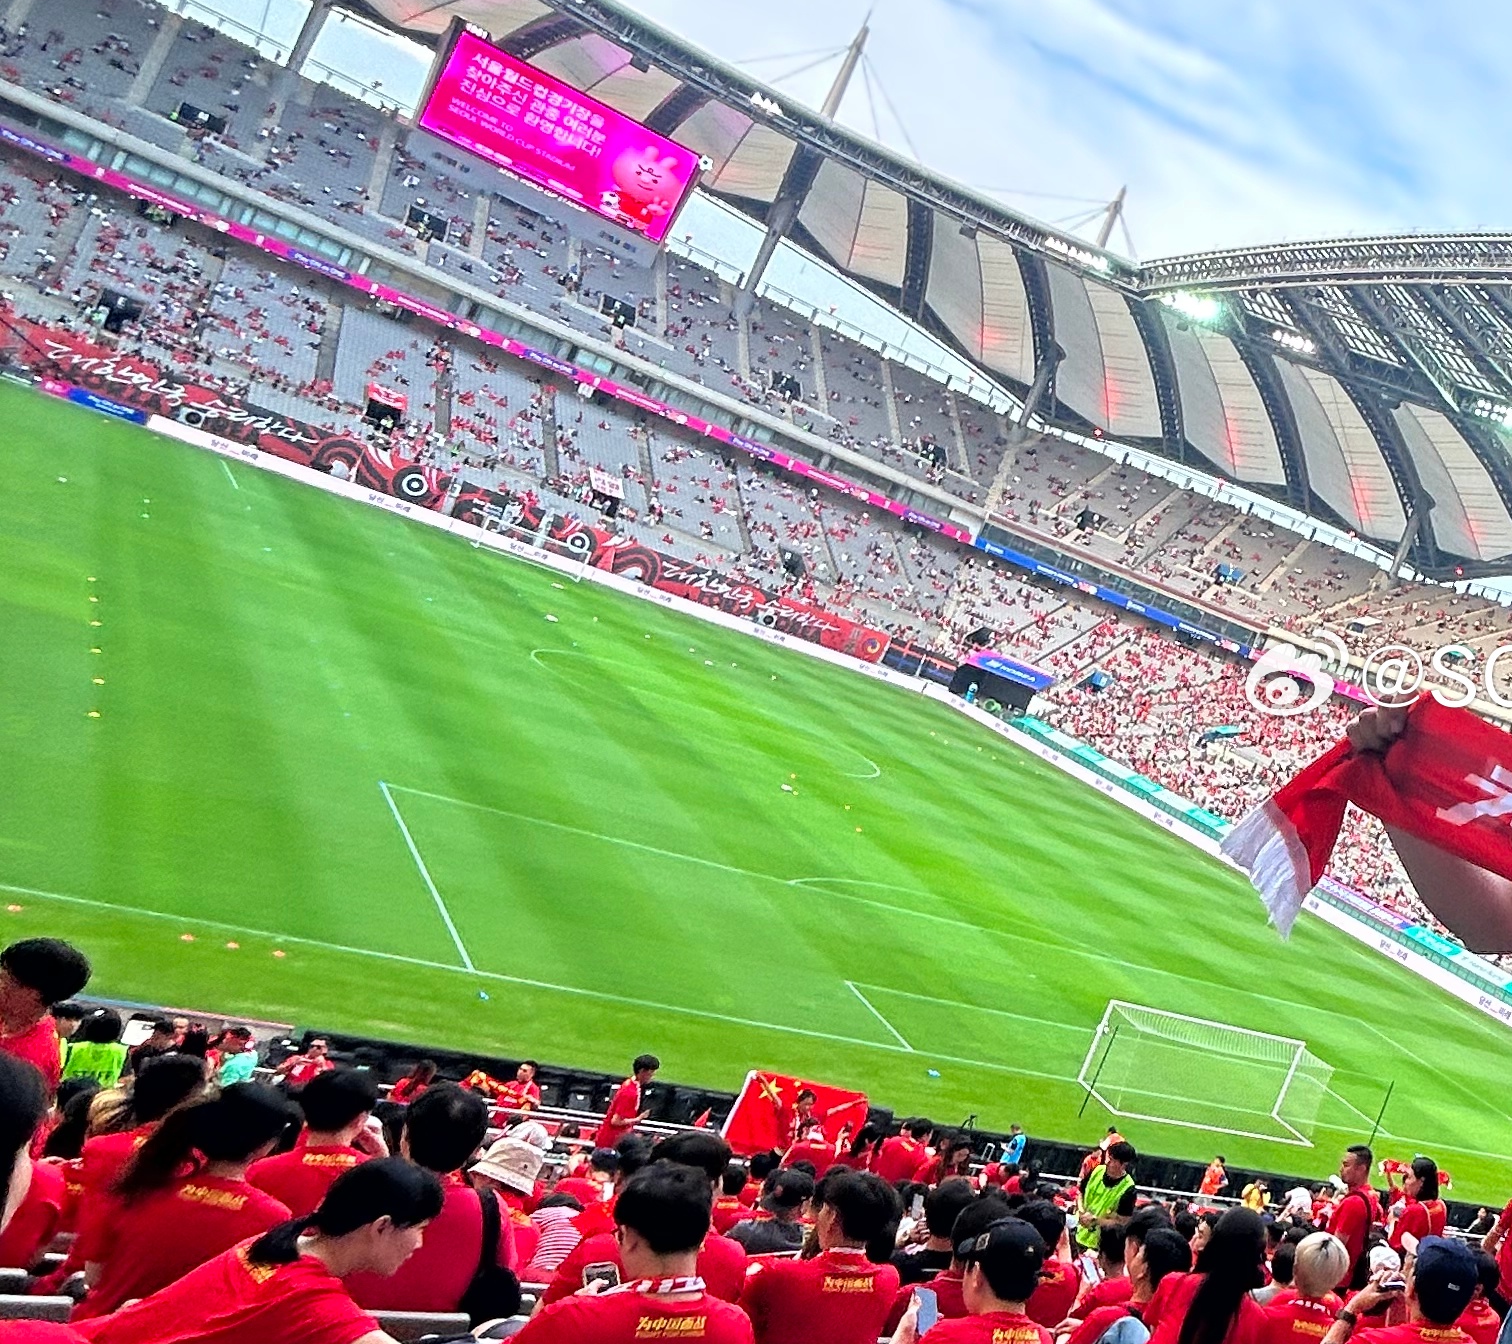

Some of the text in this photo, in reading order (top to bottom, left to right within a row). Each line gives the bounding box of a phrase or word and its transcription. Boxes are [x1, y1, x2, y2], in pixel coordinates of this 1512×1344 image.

[460, 78, 521, 118] 진심으로
[466, 65, 528, 103] 찾아주신
[451, 96, 514, 133] WELCOME TO
[481, 121, 515, 141] WORLD
[516, 138, 534, 152] CUP
